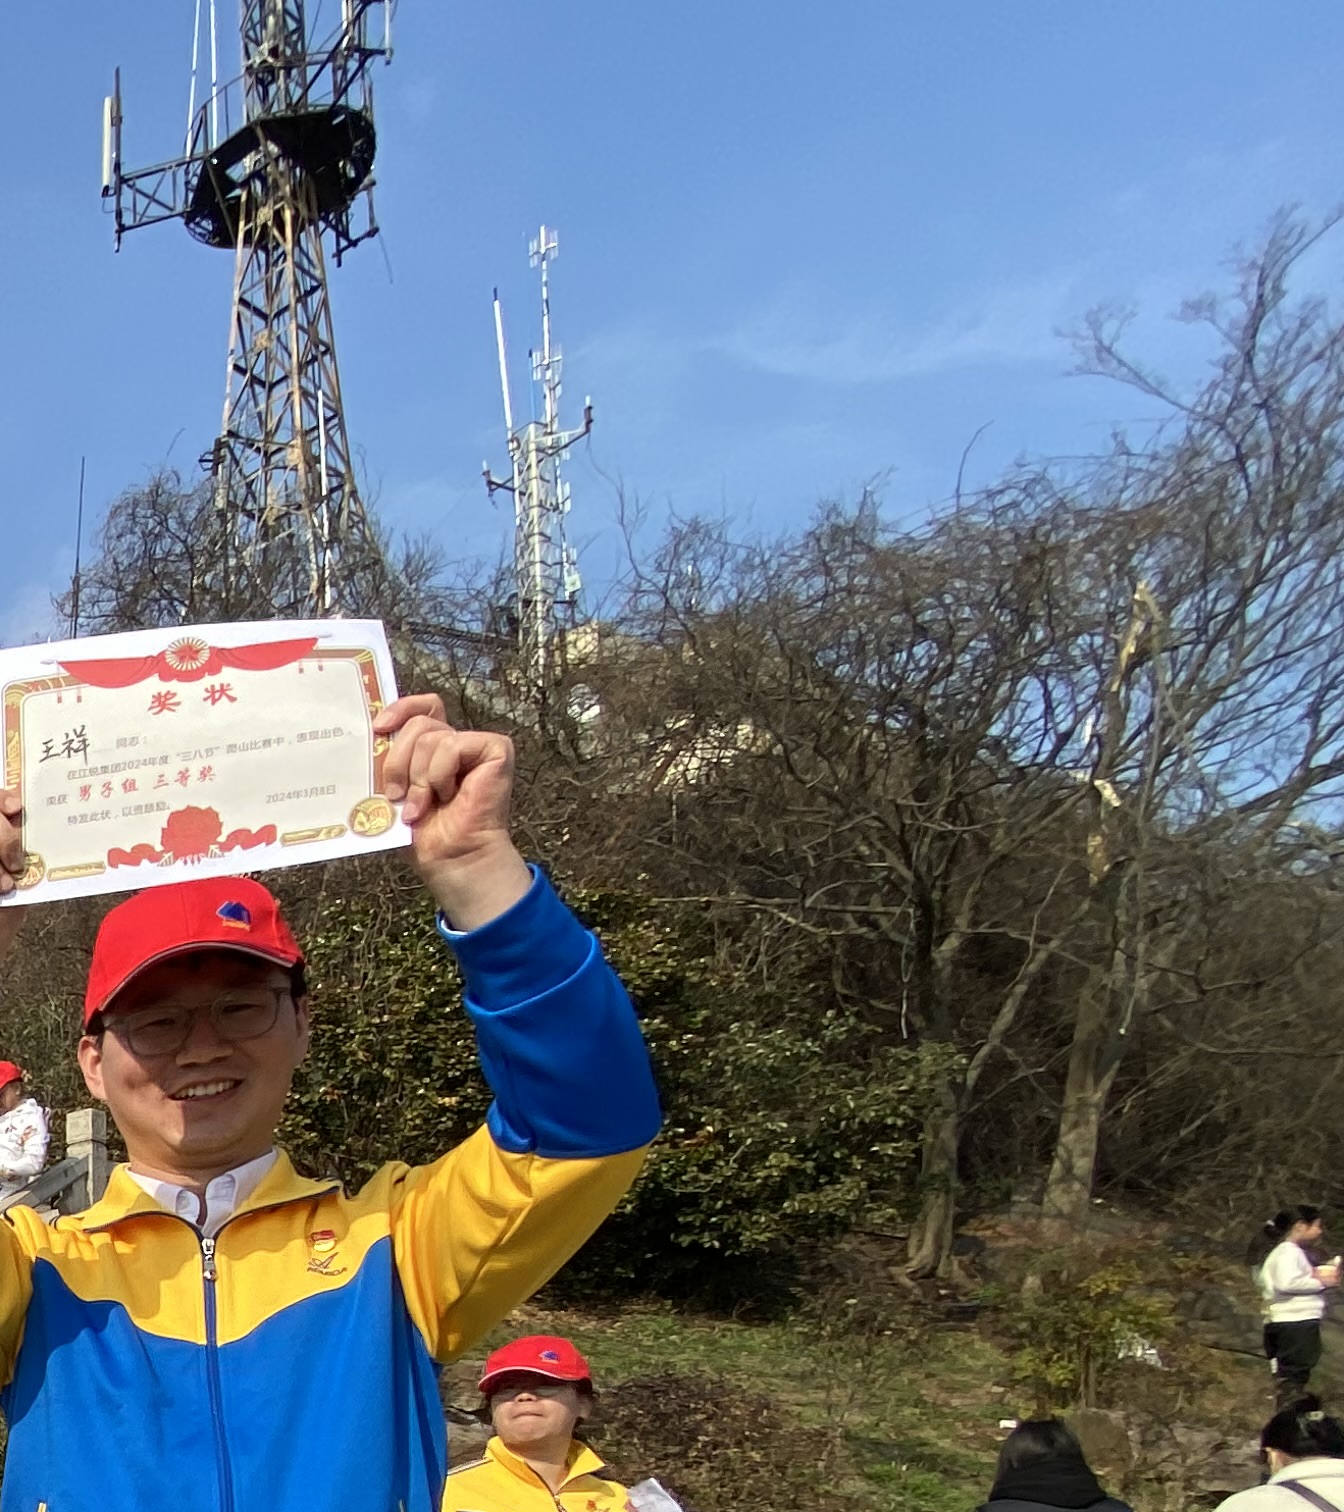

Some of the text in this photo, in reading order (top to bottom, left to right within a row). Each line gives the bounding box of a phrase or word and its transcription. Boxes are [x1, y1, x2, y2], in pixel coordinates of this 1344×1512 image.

[147, 682, 239, 715] 奖状
[38, 724, 90, 766] 王祥
[153, 765, 216, 789] 三等奖
